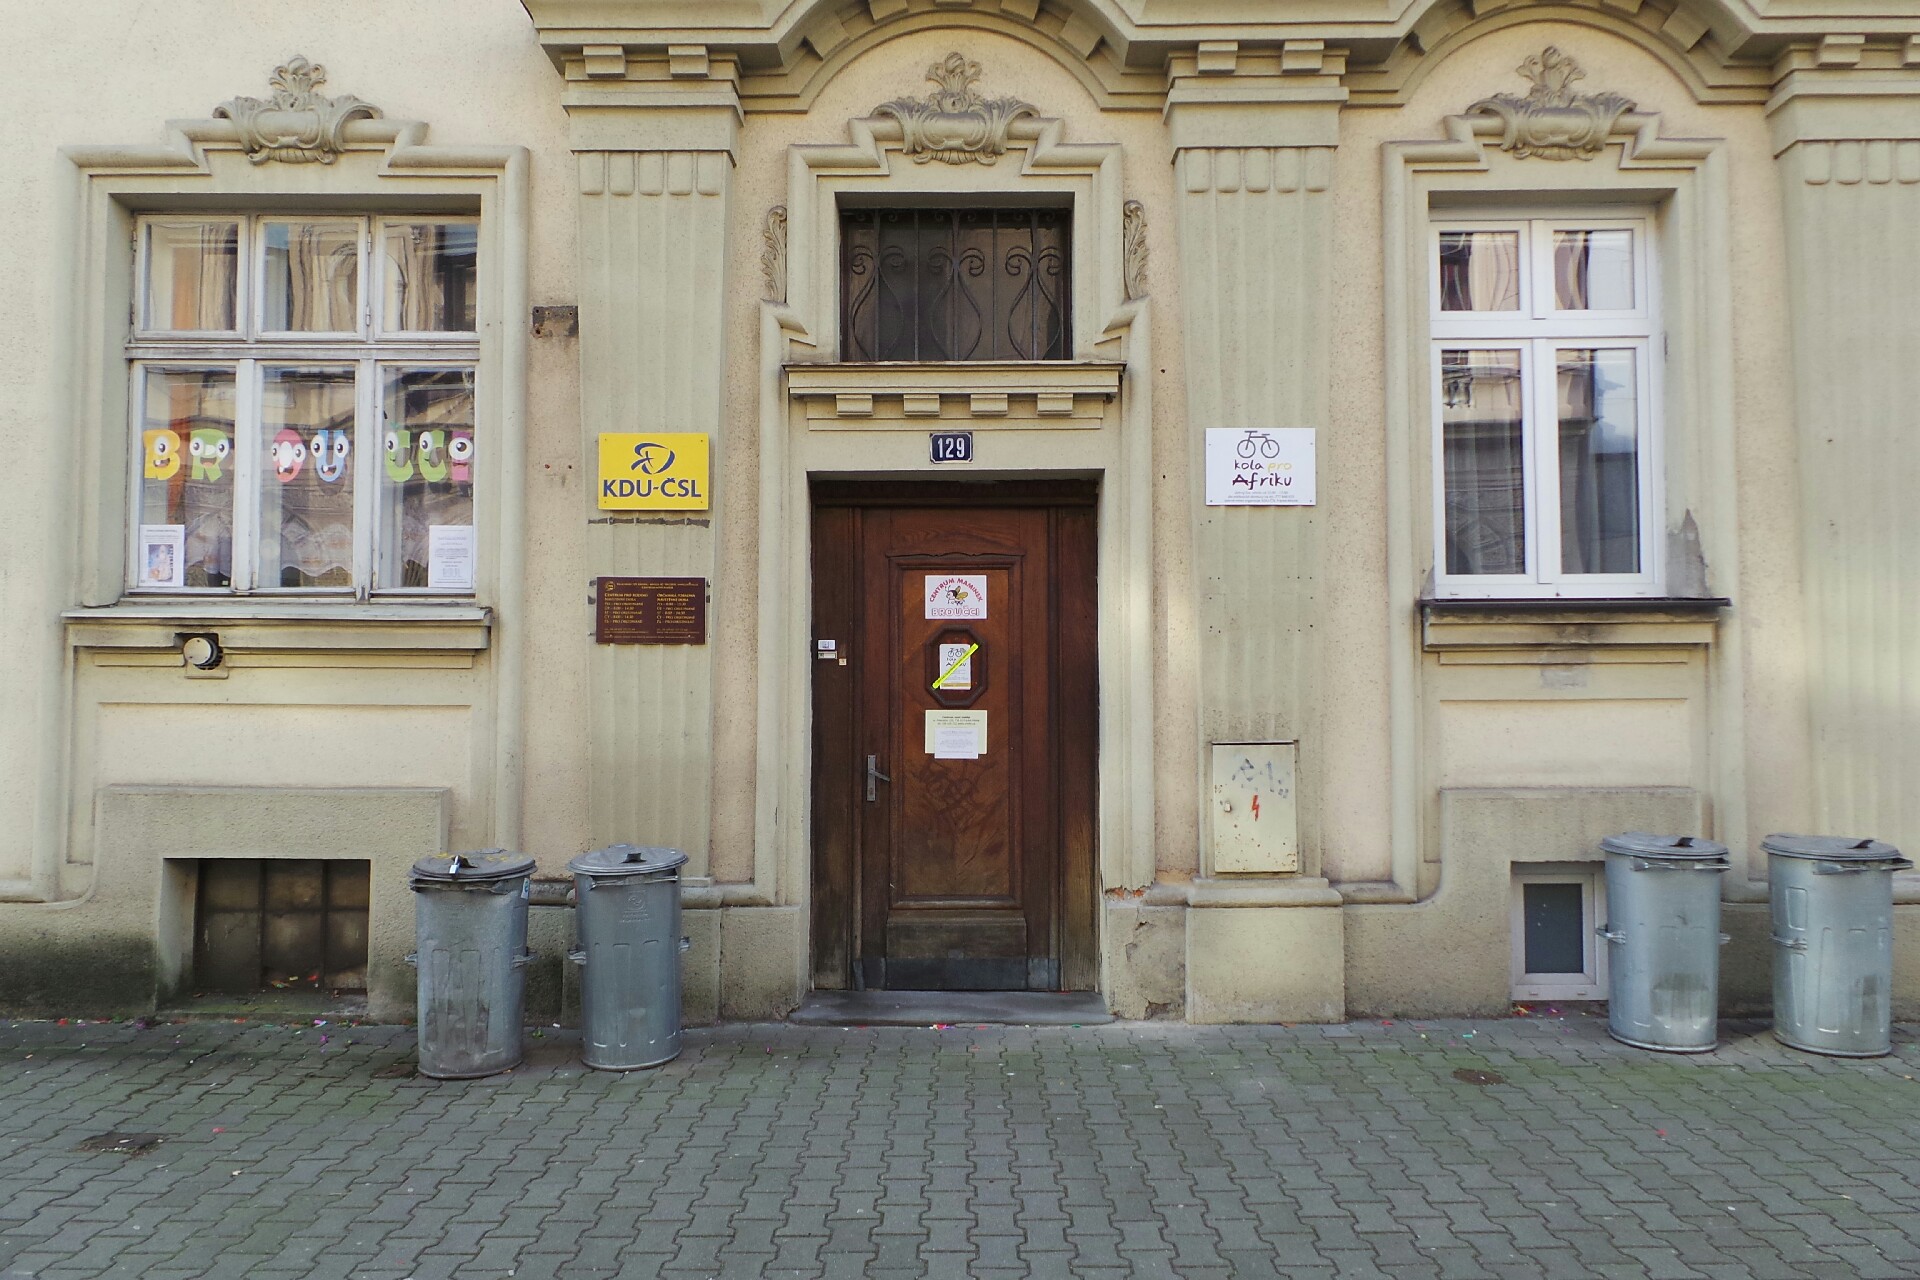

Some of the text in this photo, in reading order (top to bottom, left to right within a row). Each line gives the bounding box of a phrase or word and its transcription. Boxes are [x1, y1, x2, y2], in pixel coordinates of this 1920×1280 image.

[937, 437, 965, 458] 129
[1234, 459, 1292, 472] kola pro
[603, 477, 702, 498] KDU-ČSL
[1232, 472, 1292, 490] Afriku
[929, 578, 983, 602] CENTRUM MAMINEK
